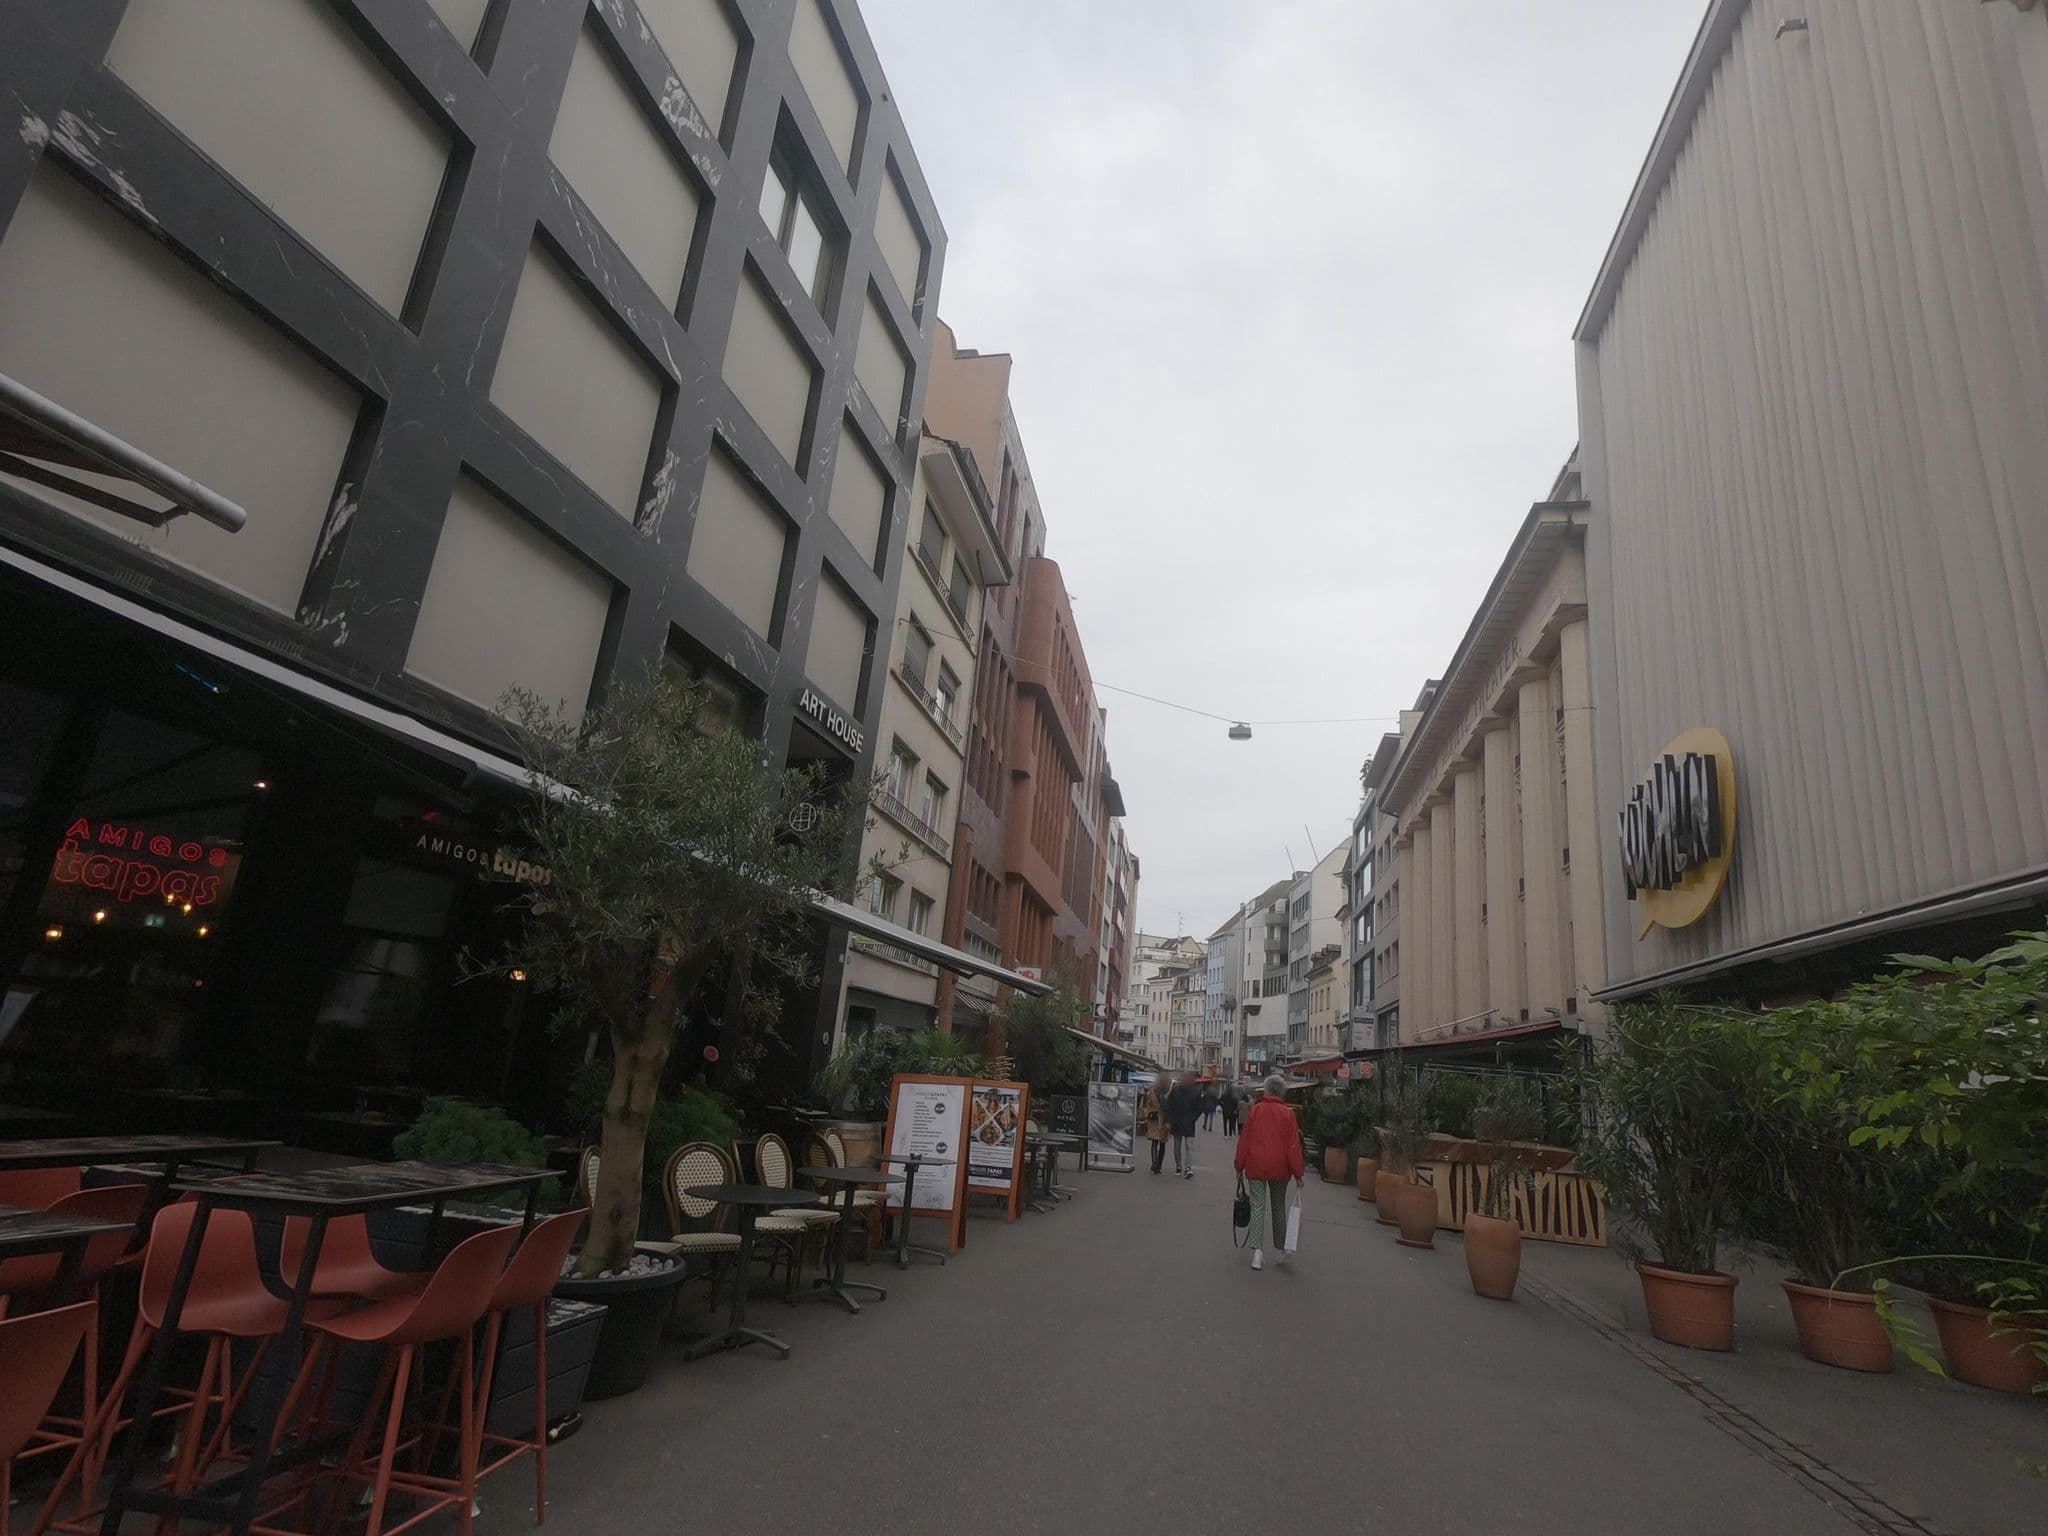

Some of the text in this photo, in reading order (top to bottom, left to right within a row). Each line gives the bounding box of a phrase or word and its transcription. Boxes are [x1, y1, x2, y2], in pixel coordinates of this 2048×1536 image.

[799, 688, 865, 754] ART HOUSE
[65, 816, 229, 868] AMIGOS
[416, 834, 489, 865] AMIGOS
[53, 838, 222, 906] tapas
